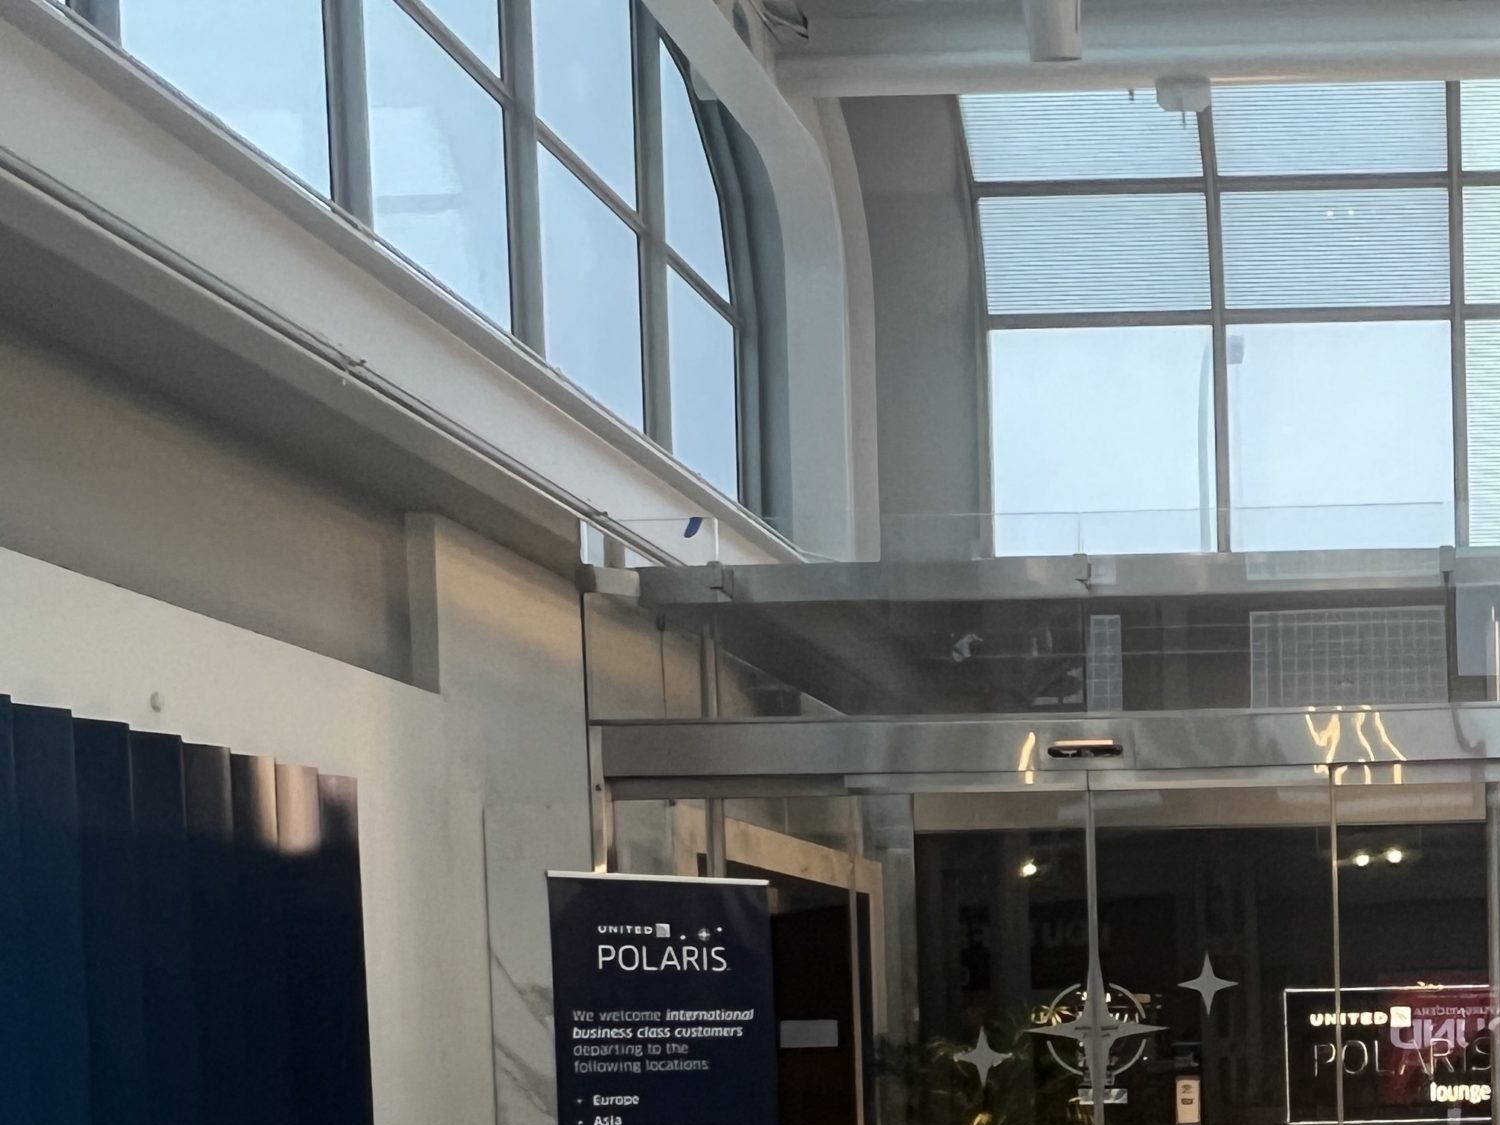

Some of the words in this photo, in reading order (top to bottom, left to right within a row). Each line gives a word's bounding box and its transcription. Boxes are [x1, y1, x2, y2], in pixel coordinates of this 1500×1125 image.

[597, 925, 653, 935] UNITED
[597, 945, 728, 972] POLARIS
[572, 1009, 594, 1022] We
[599, 1009, 662, 1022] welcome
[665, 1009, 755, 1021] international
[1309, 1011, 1388, 1026] UNITED
[572, 1026, 633, 1039] business
[637, 1026, 671, 1038] class
[674, 1026, 743, 1037] customers
[573, 1044, 643, 1057] departing
[647, 1043, 662, 1055] to
[666, 1043, 689, 1054] the
[1313, 1037, 1493, 1077] POLARIS
[574, 1060, 642, 1074] following
[593, 1094, 640, 1106] Europe
[1430, 1082, 1491, 1104] lounge
